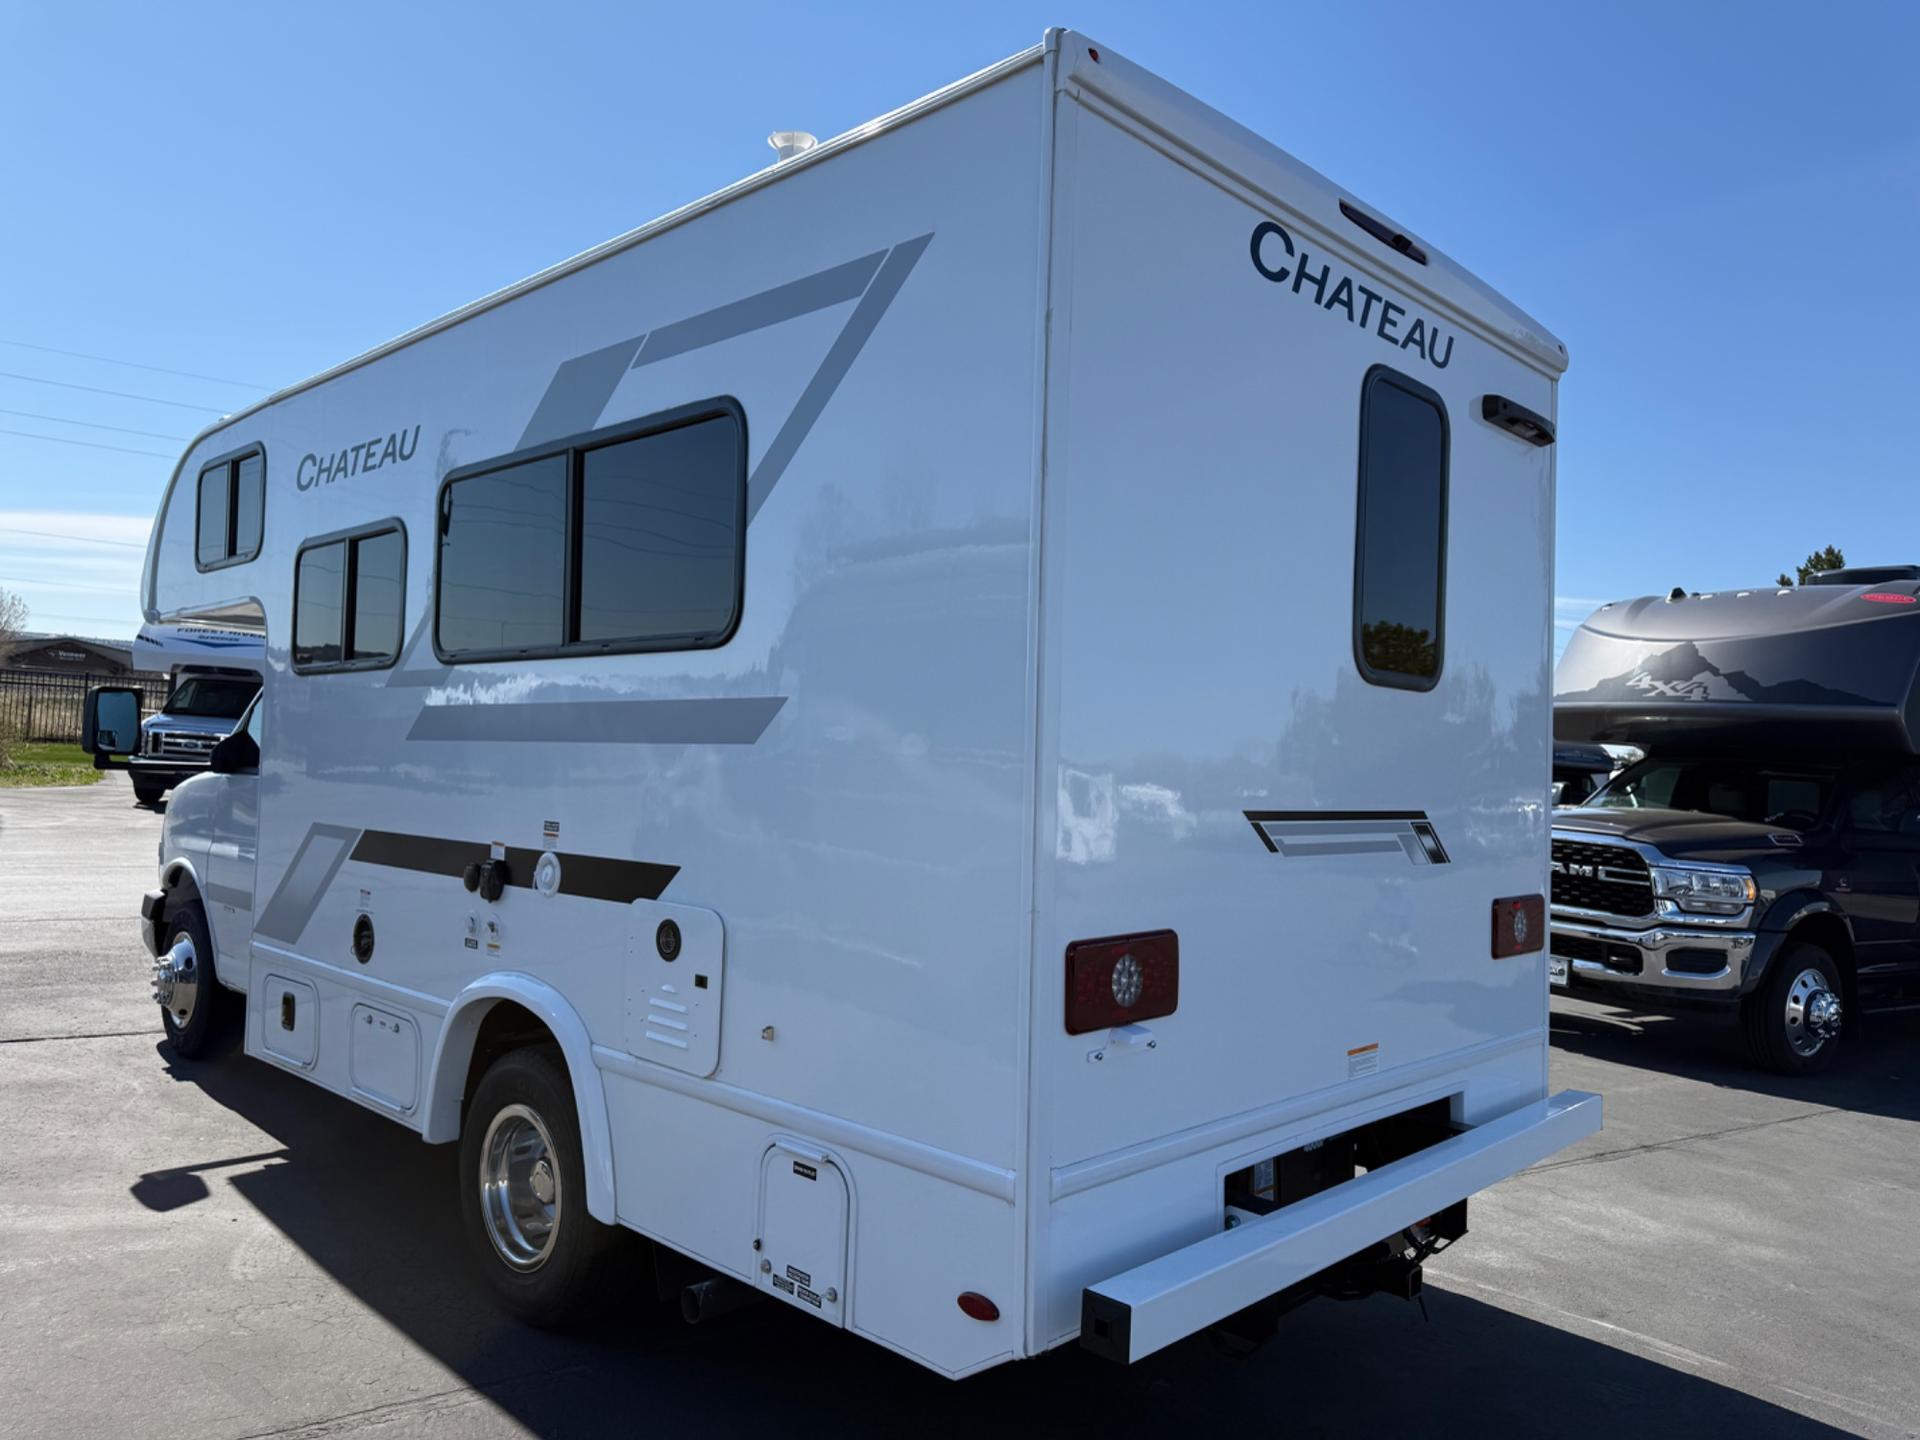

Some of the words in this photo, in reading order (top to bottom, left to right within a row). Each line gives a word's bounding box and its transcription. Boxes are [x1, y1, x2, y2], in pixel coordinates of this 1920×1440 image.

[1251, 221, 1454, 369] CHATEAU
[296, 424, 421, 491] CHATEAU
[1550, 861, 1593, 877] AM
